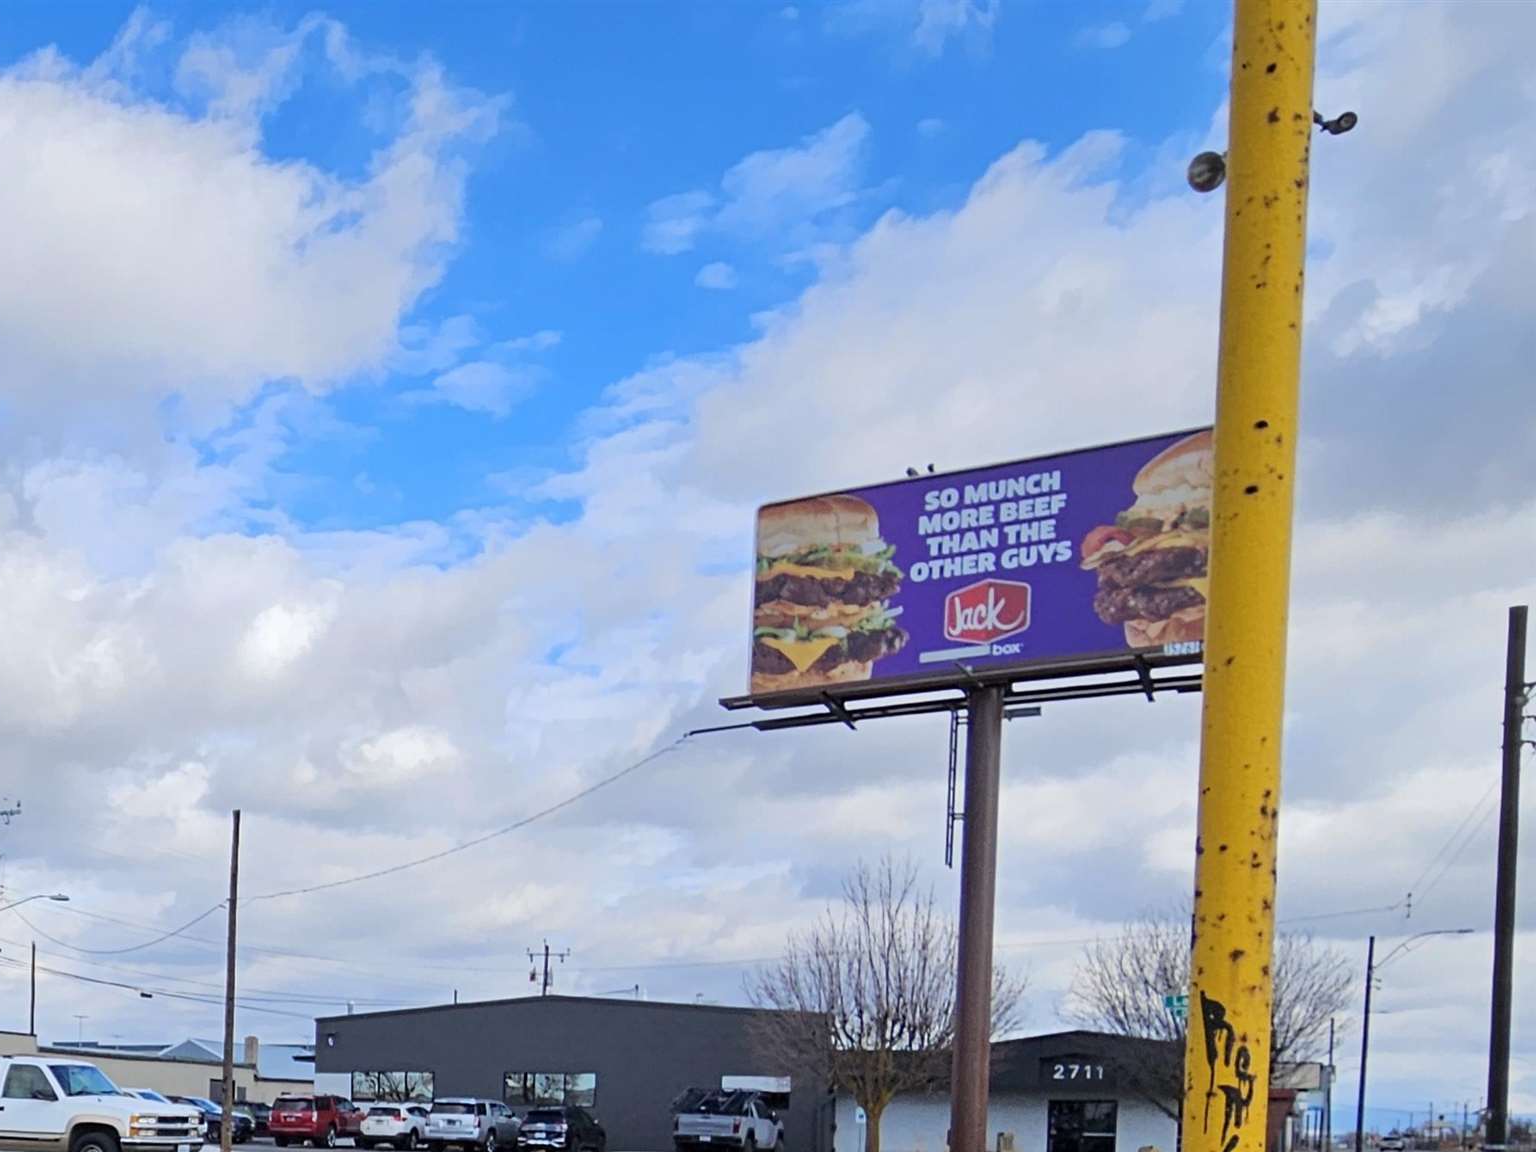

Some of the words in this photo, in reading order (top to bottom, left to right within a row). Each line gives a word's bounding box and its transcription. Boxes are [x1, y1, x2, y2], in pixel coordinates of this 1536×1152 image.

[924, 487, 959, 511] SO
[964, 470, 1061, 505] MUNCH
[918, 505, 995, 535] MORE
[1000, 493, 1067, 523] BEEF
[926, 528, 999, 556] THAN
[1004, 519, 1056, 545] THE
[910, 552, 996, 582] OTHER
[1001, 541, 1072, 569] GUYS
[948, 587, 1025, 636] Jack
[992, 643, 1021, 656] box
[1053, 1063, 1104, 1080] 2711
